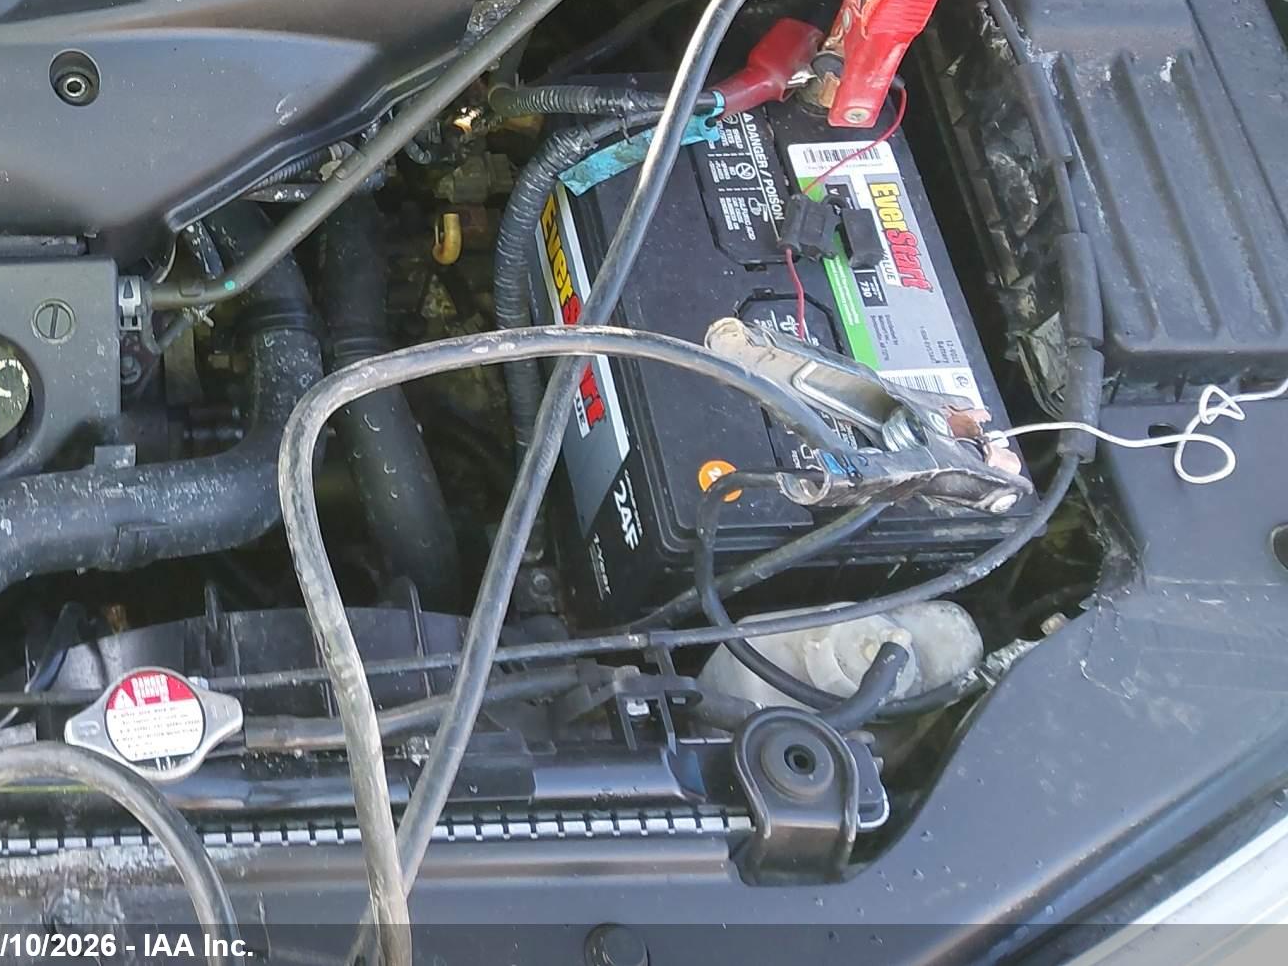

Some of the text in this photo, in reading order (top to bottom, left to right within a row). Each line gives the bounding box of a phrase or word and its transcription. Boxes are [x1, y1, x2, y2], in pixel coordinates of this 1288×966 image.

[745, 122, 769, 170] DANGER
[762, 178, 785, 221] POISON
[868, 181, 933, 292] EverStart
[541, 191, 606, 428] EverSrt
[858, 280, 872, 298] 730
[936, 339, 950, 365] Battery
